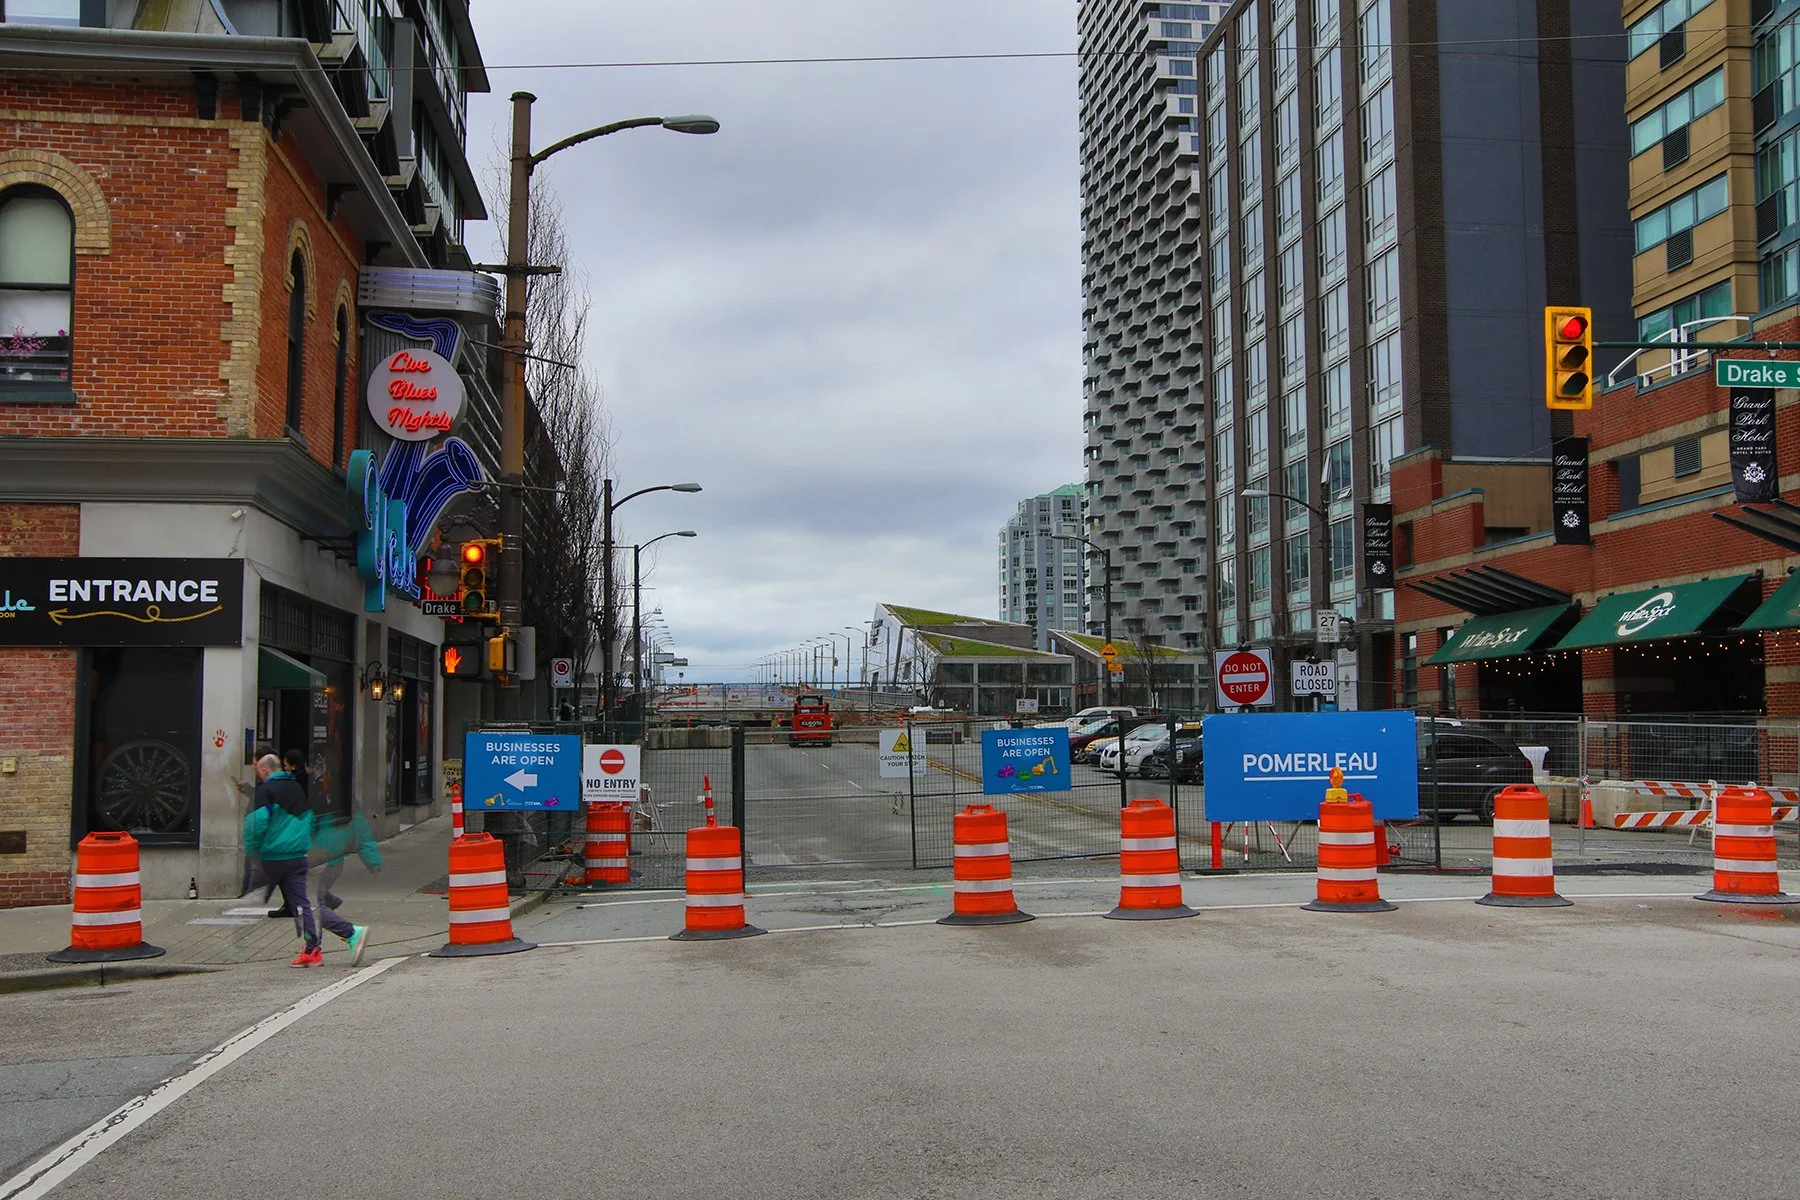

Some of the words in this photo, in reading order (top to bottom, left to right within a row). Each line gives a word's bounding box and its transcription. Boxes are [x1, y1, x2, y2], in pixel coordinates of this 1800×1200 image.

[388, 351, 432, 373] Live
[1727, 364, 1787, 383] Drake
[387, 378, 438, 400] Blues
[1733, 396, 1771, 409] Grand
[387, 407, 454, 432] Nightly
[1735, 412, 1770, 425] Park
[1732, 429, 1773, 442] Hotel
[1554, 455, 1586, 466] Grand
[1556, 468, 1584, 480] Park
[1554, 482, 1586, 493] Hotel
[0, 590, 36, 611] le
[49, 579, 219, 602] ENTRANCE
[425, 602, 456, 614] Drake
[1320, 616, 1335, 626] 27
[1225, 663, 1239, 673] DO
[1242, 662, 1261, 672] NOT
[1300, 665, 1328, 676] ROAD
[1230, 683, 1260, 693] ENTER
[1294, 679, 1334, 690] CLOSED
[997, 736, 1055, 747] BUSINESSES
[486, 742, 561, 753] BUSINESSES
[1002, 749, 1022, 758] ARE
[1024, 748, 1051, 757] OPEN
[491, 755, 517, 765] ARE
[520, 755, 554, 765] OPEN
[1243, 752, 1378, 773] POMERLEAU
[586, 778, 601, 789] NO
[604, 778, 636, 789] ENTRY
